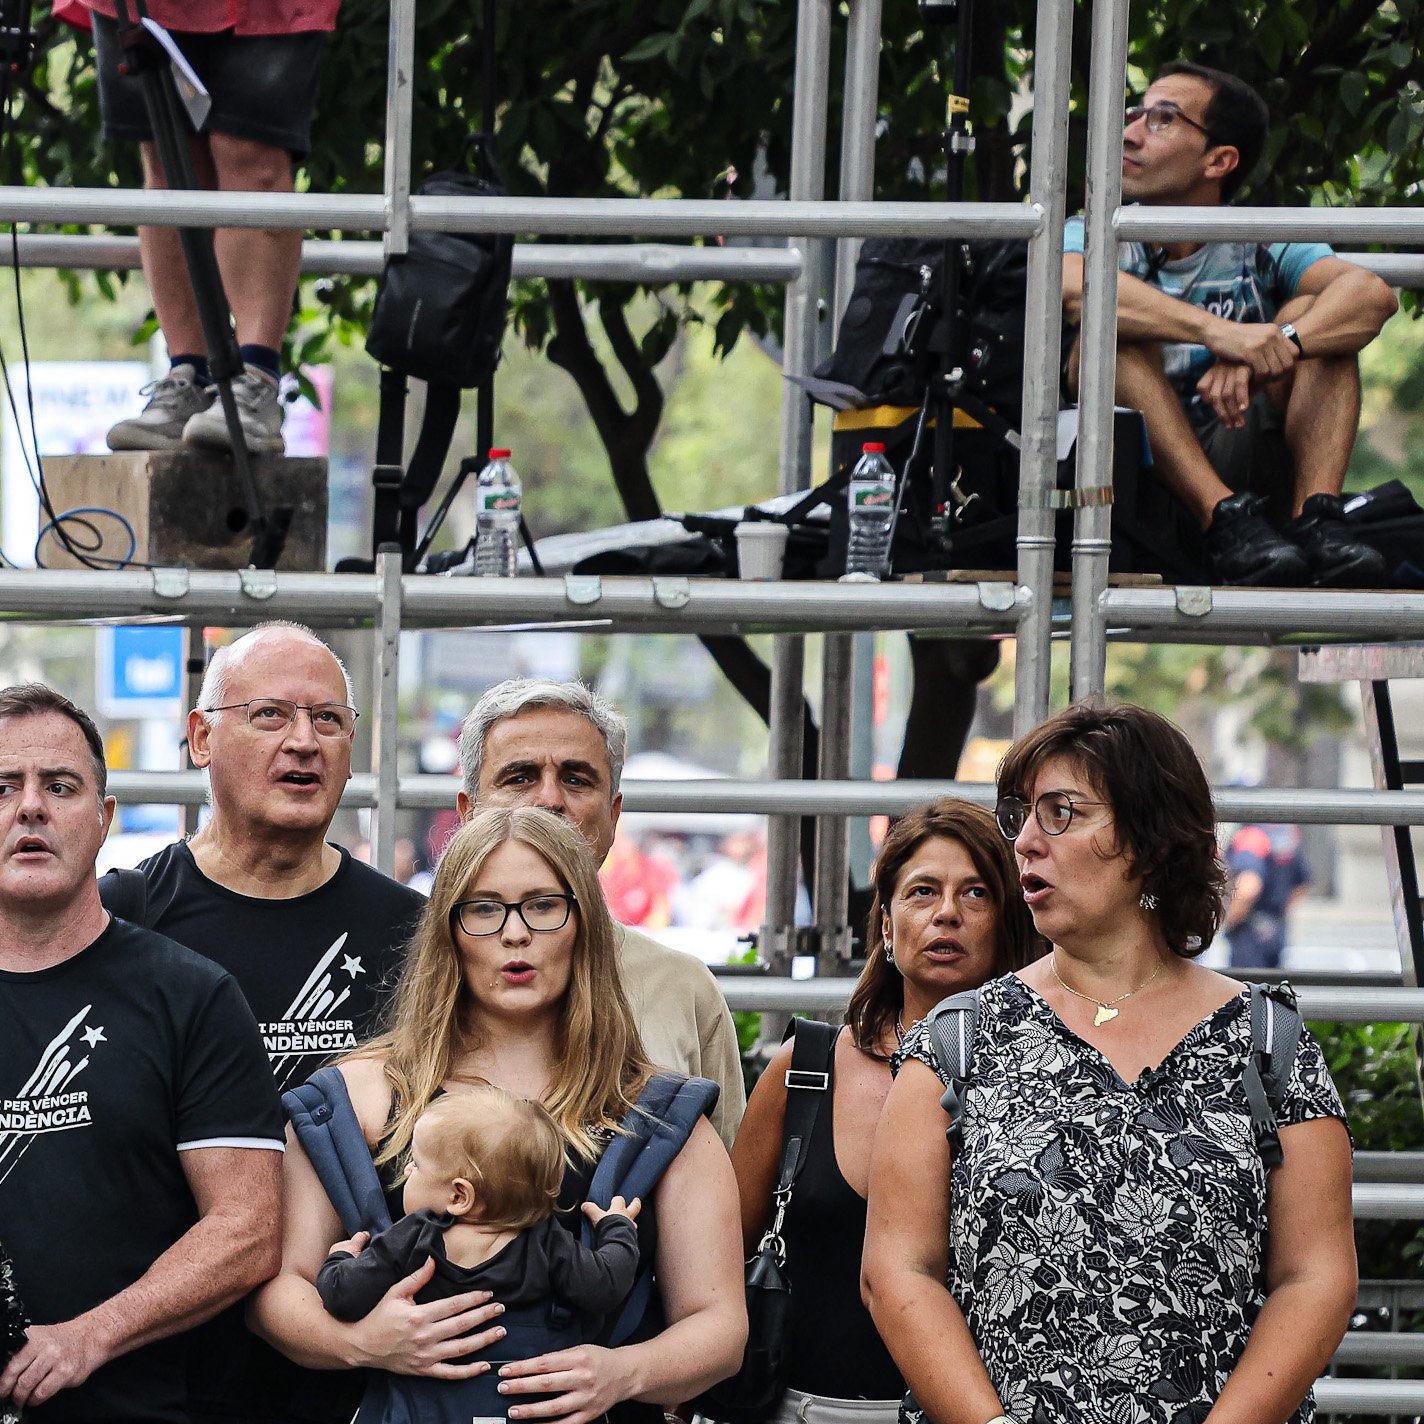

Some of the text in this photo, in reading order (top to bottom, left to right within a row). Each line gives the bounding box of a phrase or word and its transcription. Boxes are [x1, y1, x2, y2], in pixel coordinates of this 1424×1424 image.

[269, 1022, 295, 1034] PER
[298, 1019, 353, 1033] VÈNCER
[3, 1100, 30, 1112] PER
[32, 1091, 89, 1111] VÈNCER
